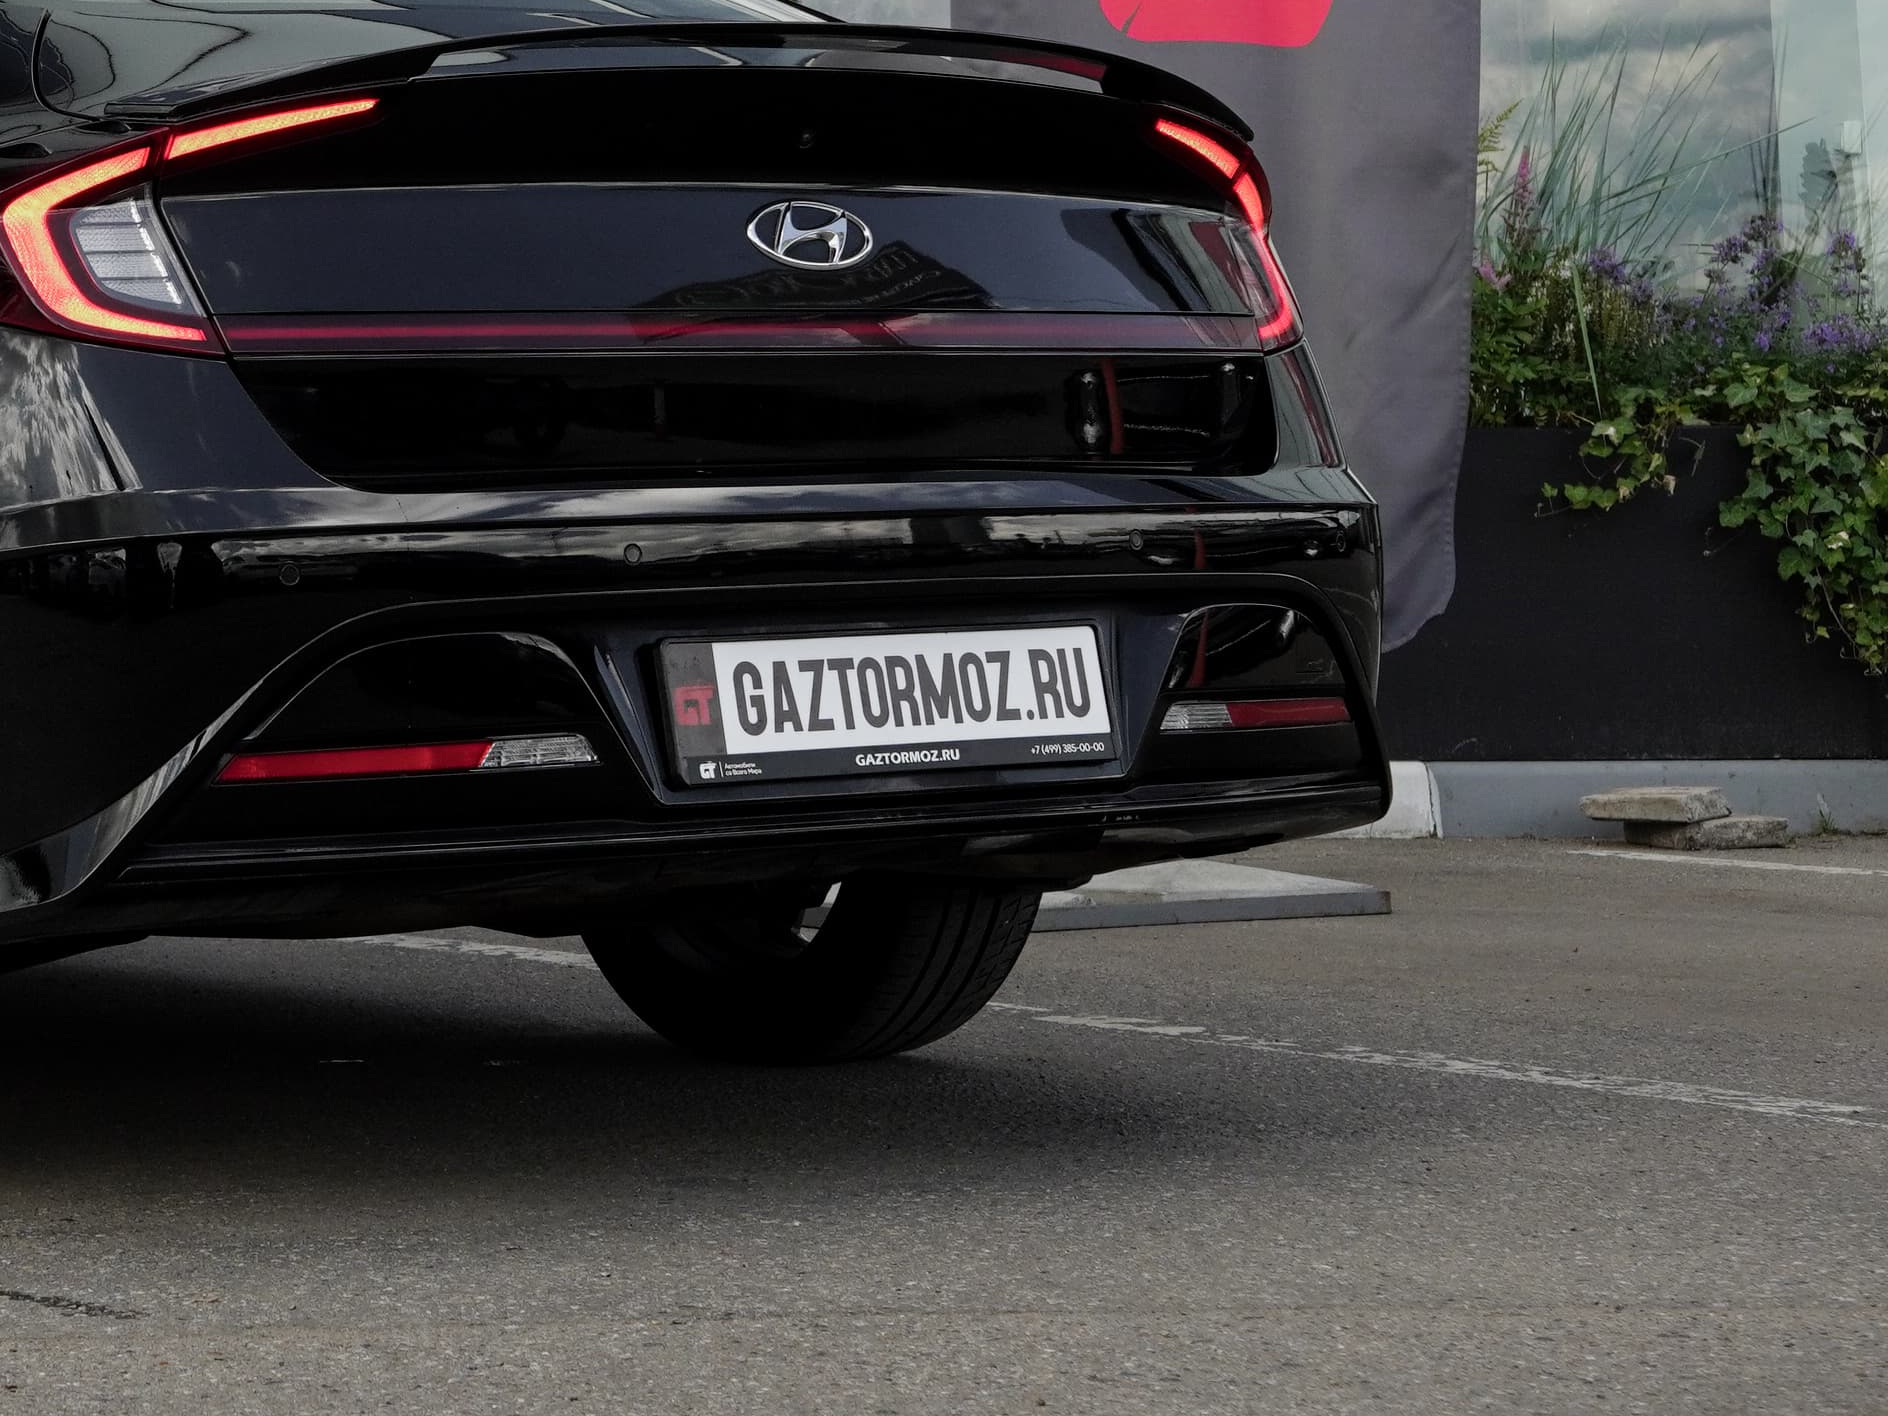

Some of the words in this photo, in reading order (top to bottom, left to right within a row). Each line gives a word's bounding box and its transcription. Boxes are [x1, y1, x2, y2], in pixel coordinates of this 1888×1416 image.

[674, 685, 714, 726] GT
[732, 646, 1092, 736] GAZTORMOZ.RU
[855, 747, 961, 767] GAZTORMOZ.RU
[1040, 743, 1062, 756] (499)
[1062, 742, 1105, 753] 385-00-00
